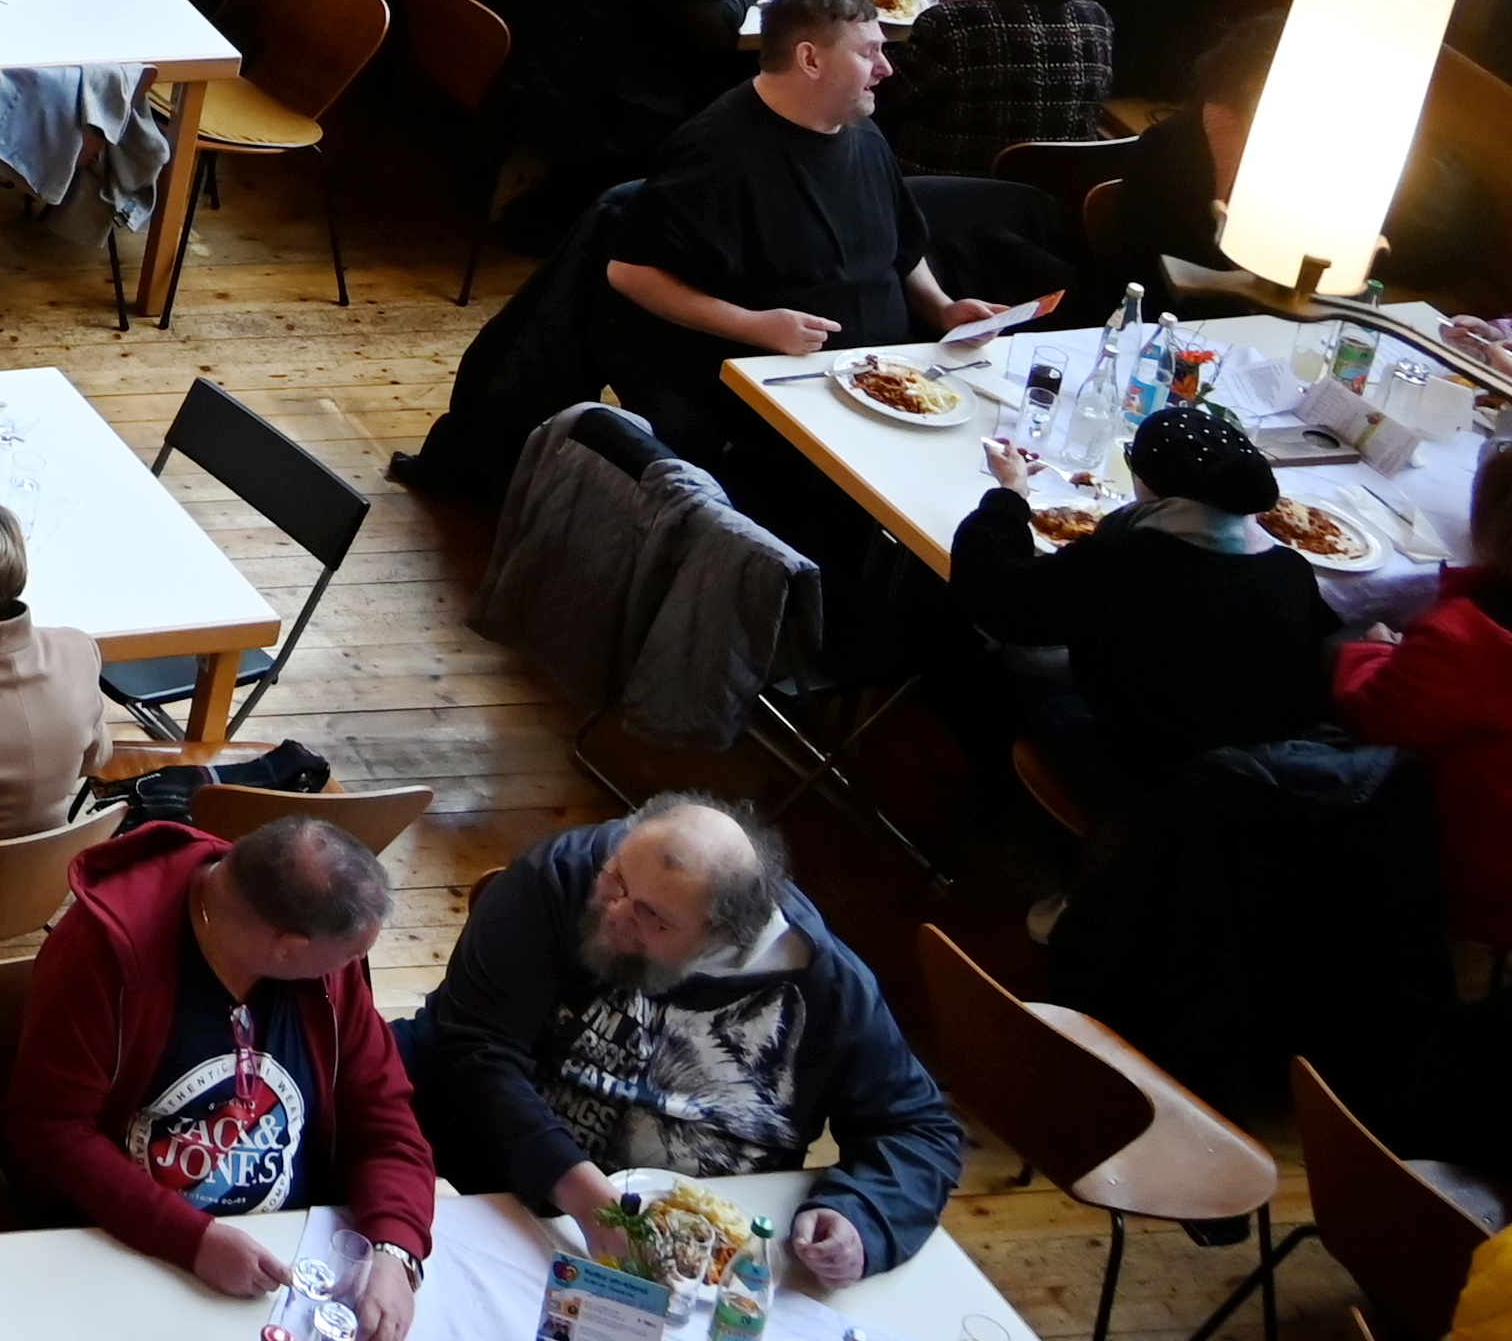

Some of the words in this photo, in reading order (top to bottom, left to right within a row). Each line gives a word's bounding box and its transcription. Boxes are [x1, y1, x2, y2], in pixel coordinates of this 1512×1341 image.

[167, 1116, 254, 1150] JACK
[254, 1114, 284, 1149] &
[157, 1137, 280, 1187] JONES
